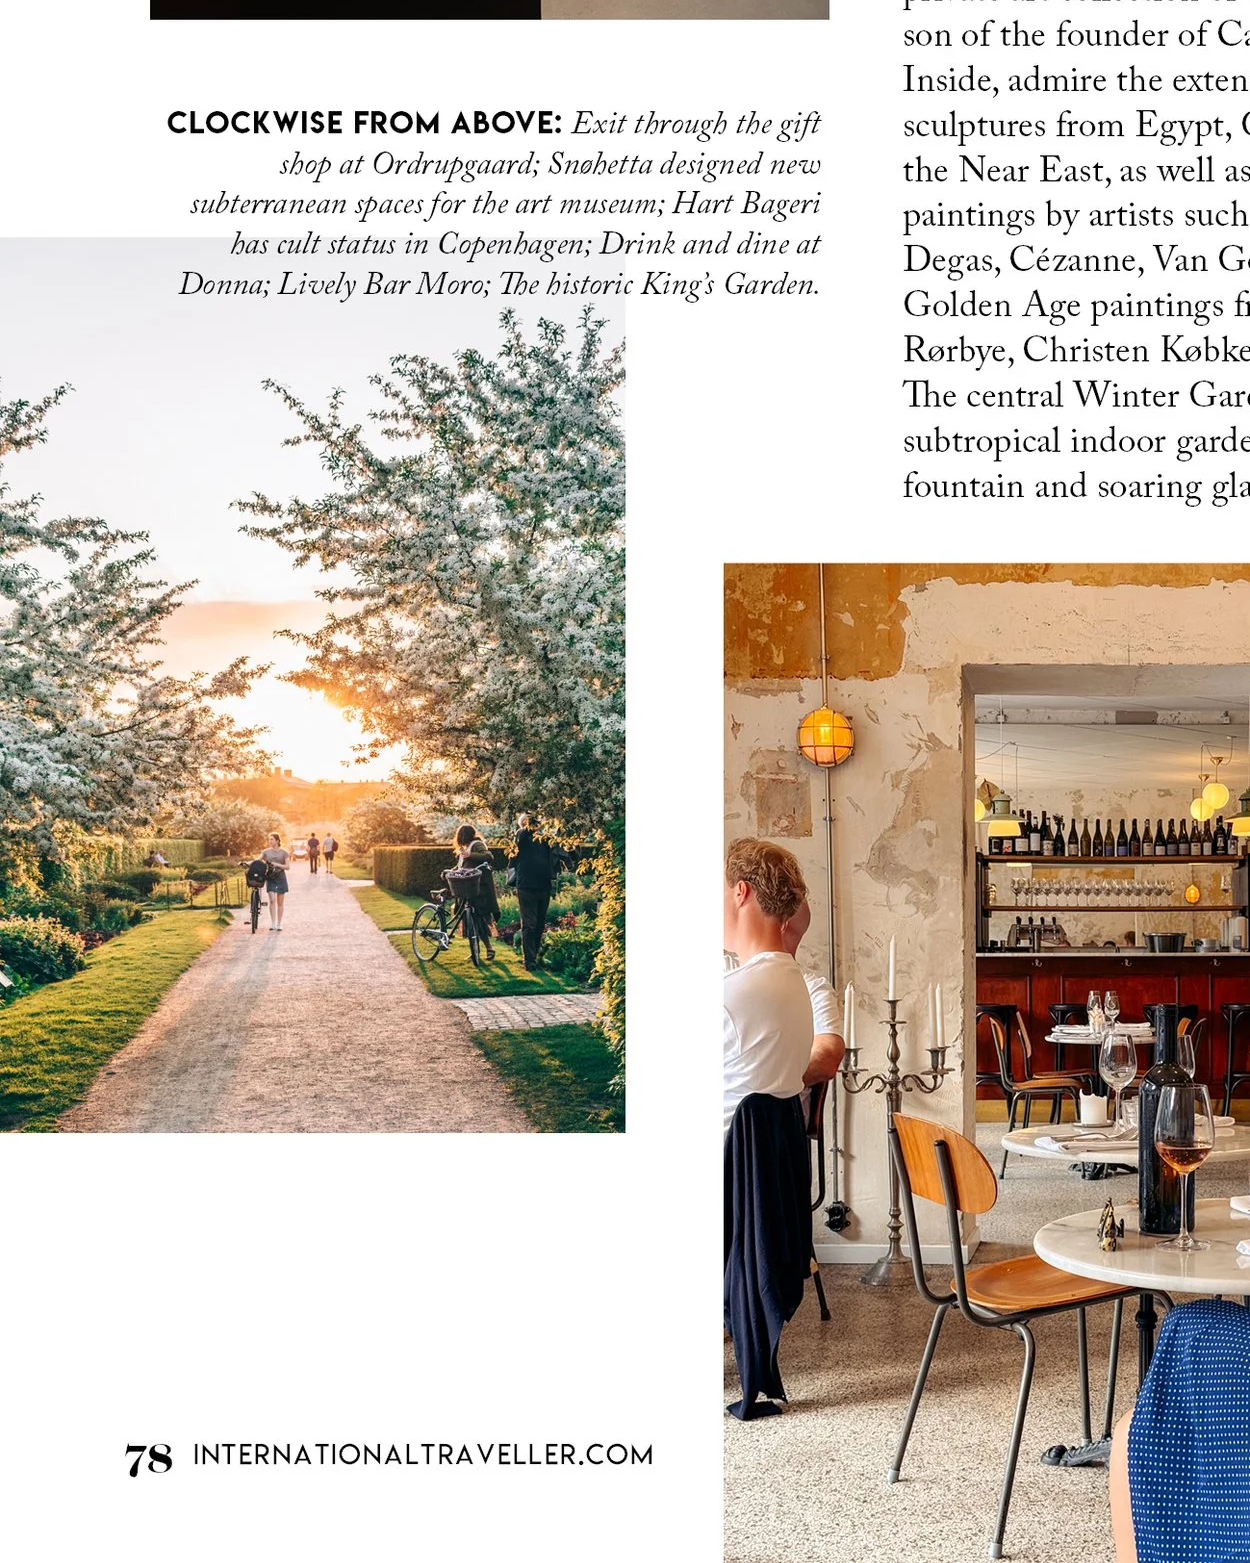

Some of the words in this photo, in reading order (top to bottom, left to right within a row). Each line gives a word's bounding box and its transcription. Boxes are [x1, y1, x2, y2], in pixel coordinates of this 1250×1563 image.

[168, 111, 342, 133] CLOCKWISE
[355, 111, 439, 133] FROM
[451, 111, 561, 133] ABOVE:
[571, 111, 627, 133] Exit
[635, 111, 727, 142] through
[737, 111, 772, 134] the
[777, 111, 822, 142] gift
[280, 151, 331, 183] shop
[340, 156, 364, 174] at
[374, 151, 539, 182] Ordrupgaard;
[549, 151, 652, 175] Snøhetta
[660, 151, 763, 182] designed
[771, 160, 820, 174] new
[190, 191, 346, 213] subterranean
[355, 197, 424, 222] spaces
[424, 191, 466, 222] for
[473, 191, 508, 214] the
[516, 195, 552, 213] art
[560, 200, 664, 217] museum;
[672, 191, 734, 213] Hart
[741, 191, 821, 222] Bageri
[231, 231, 269, 255] has
[278, 231, 321, 254] cult
[328, 236, 396, 254] status
[406, 233, 428, 254] in
[439, 231, 591, 262] Copenhagen;
[599, 231, 675, 254] Drink
[683, 231, 732, 254] and
[737, 231, 789, 254] dine
[797, 236, 822, 254] at
[904, 245, 1000, 281] Degas,
[1010, 245, 1144, 278] Cézanne,
[1153, 245, 1208, 271] Van
[178, 272, 270, 298] Donna;
[277, 272, 356, 303] Lively
[363, 272, 411, 294] Bar
[416, 272, 490, 298] Moro;
[500, 272, 539, 295] The
[546, 272, 633, 295] historic
[641, 272, 714, 303] King’s
[726, 272, 818, 294] Garden.
[125, 1444, 172, 1477] 78
[195, 1444, 652, 1465] INTERNATIONALTRAVELLER.COM
